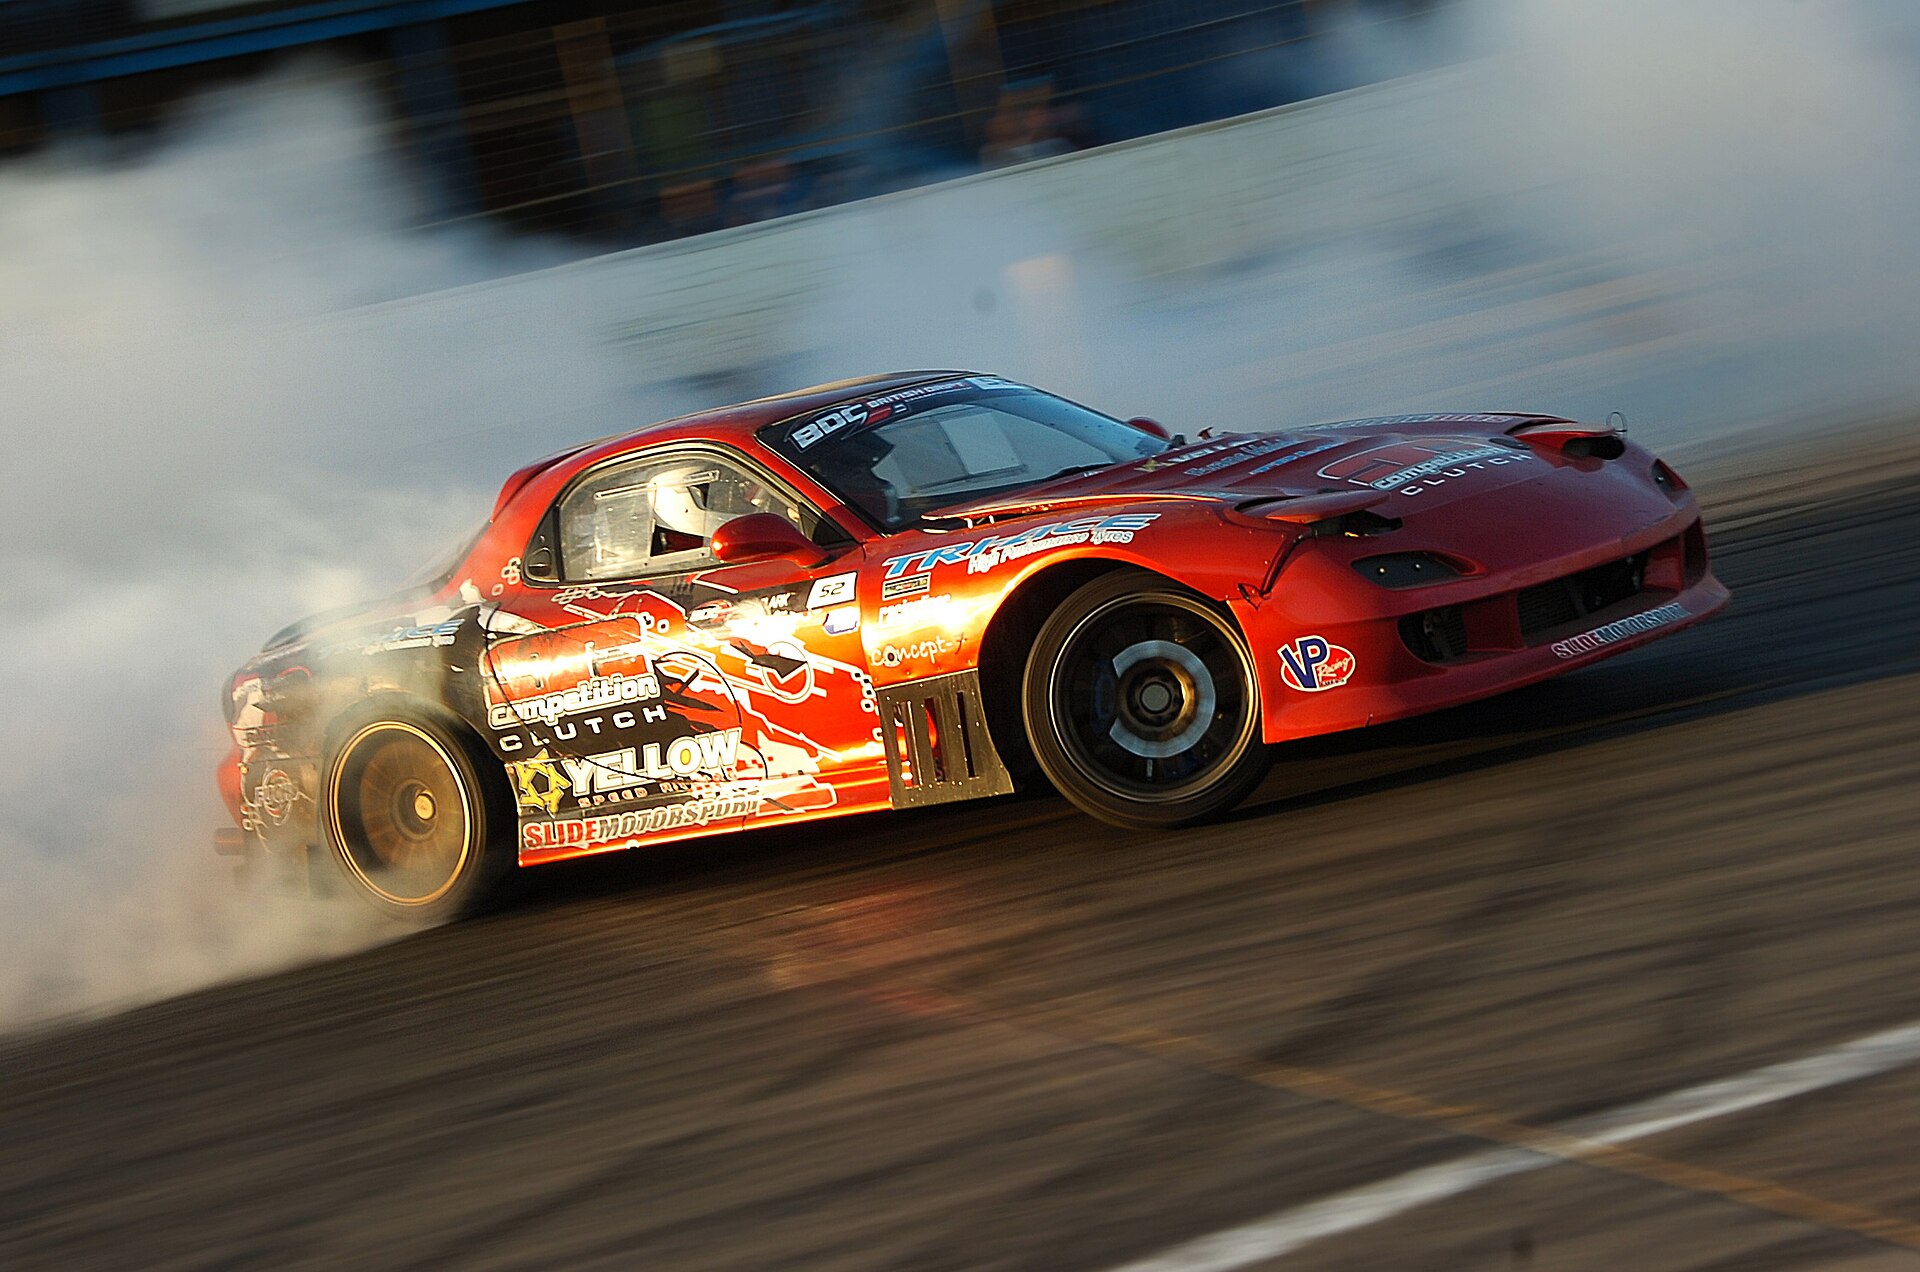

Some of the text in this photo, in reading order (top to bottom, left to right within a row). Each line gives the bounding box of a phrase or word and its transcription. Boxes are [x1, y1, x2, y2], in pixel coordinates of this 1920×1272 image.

[867, 387, 924, 408] BRITISH
[792, 403, 868, 449] BDC
[1369, 447, 1512, 490] competition
[1400, 454, 1532, 496] CLUTCH
[967, 528, 1134, 574] High Performance Tyres
[818, 581, 846, 598] 52
[1278, 636, 1330, 690] VP
[488, 673, 661, 729] competition
[499, 704, 668, 752] CLUTCH
[561, 727, 743, 797] YELLOW
[578, 787, 648, 809] SPEED
